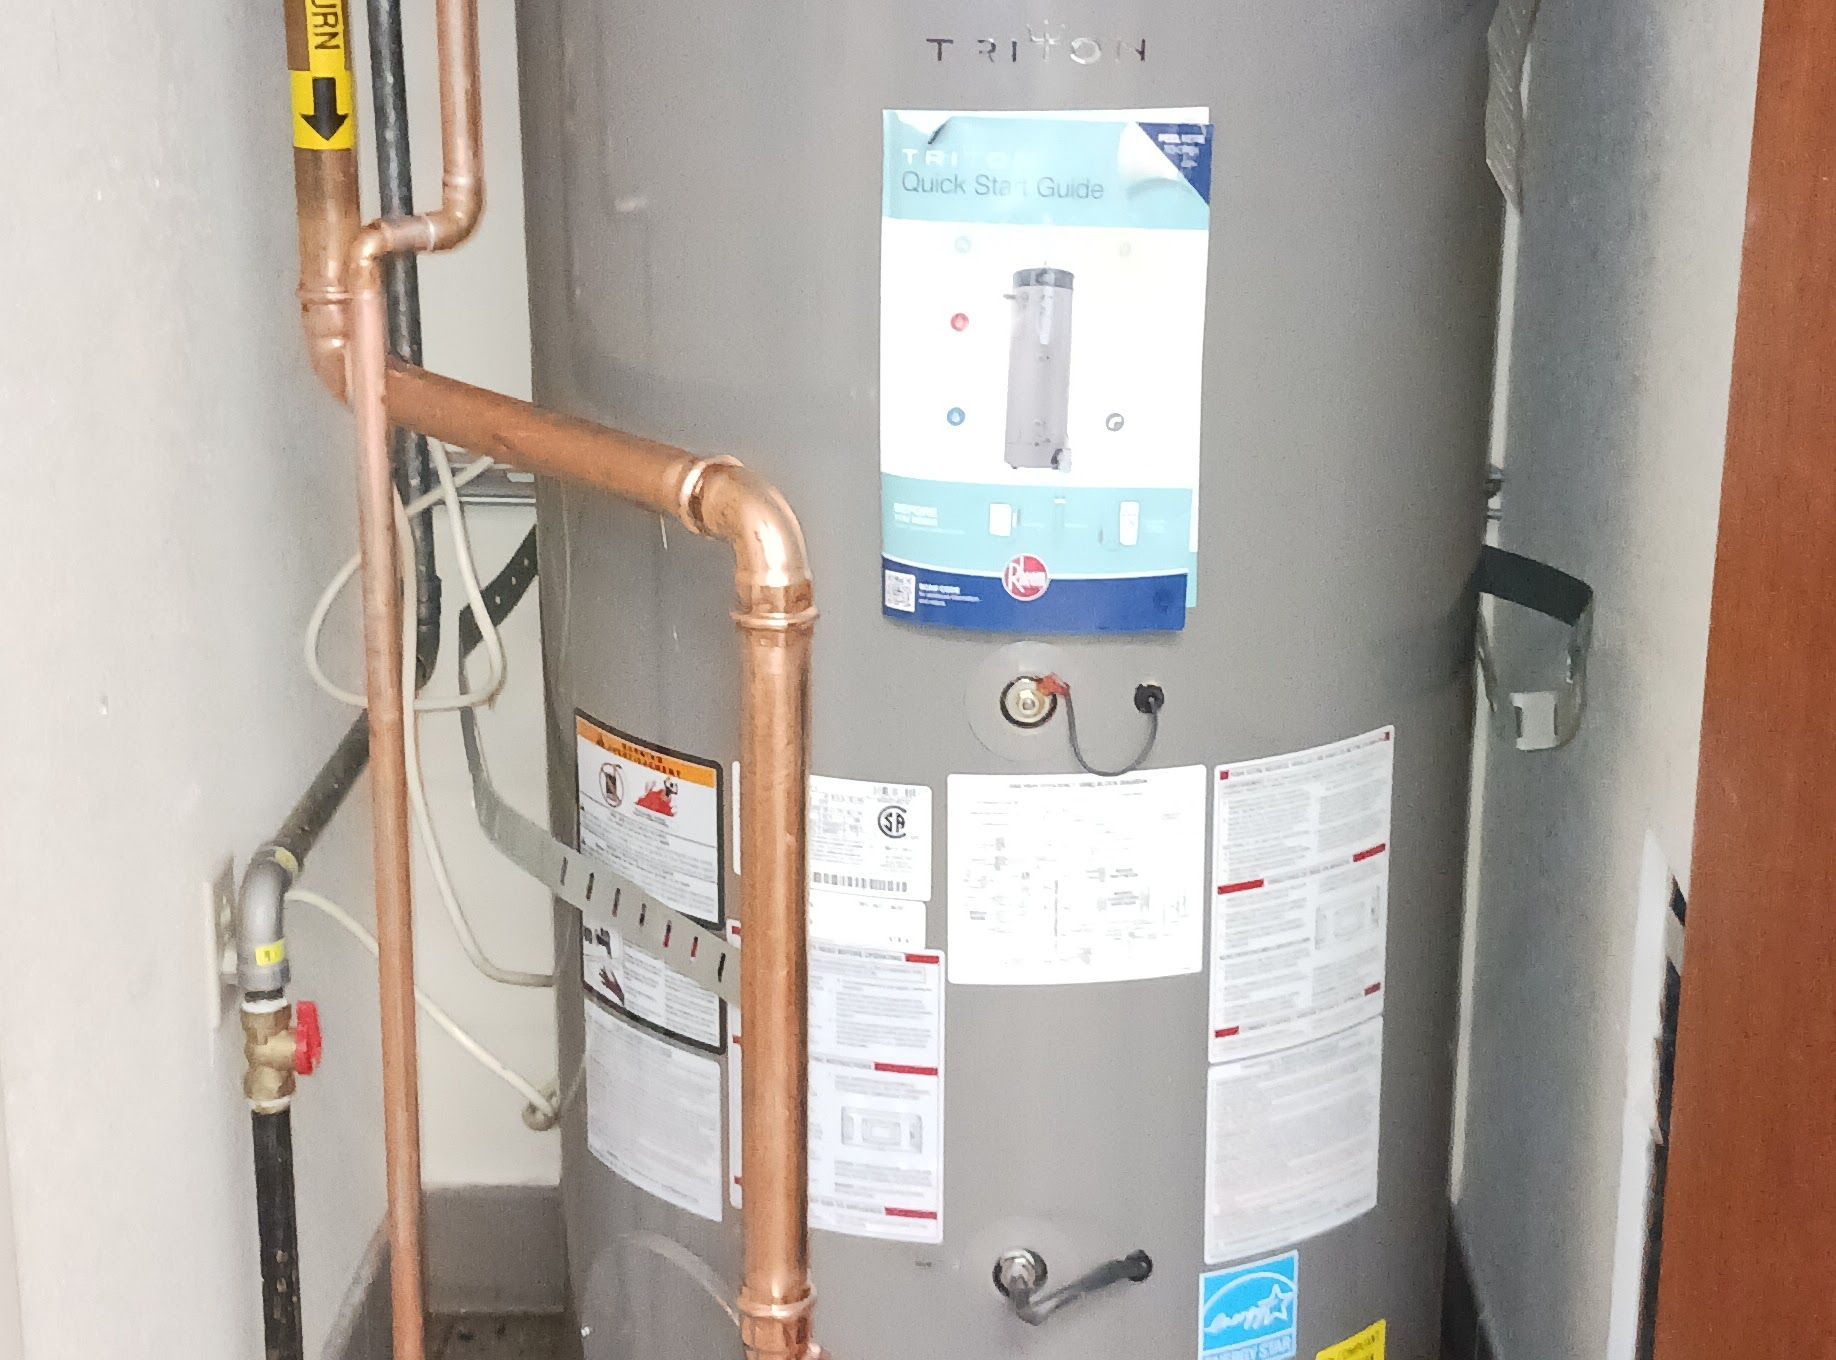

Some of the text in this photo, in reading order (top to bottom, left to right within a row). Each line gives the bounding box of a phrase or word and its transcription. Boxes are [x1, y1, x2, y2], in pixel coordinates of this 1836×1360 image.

[901, 170, 966, 195] Quick
[1036, 176, 1105, 201] Guide
[1258, 1335, 1293, 1358] STAR
